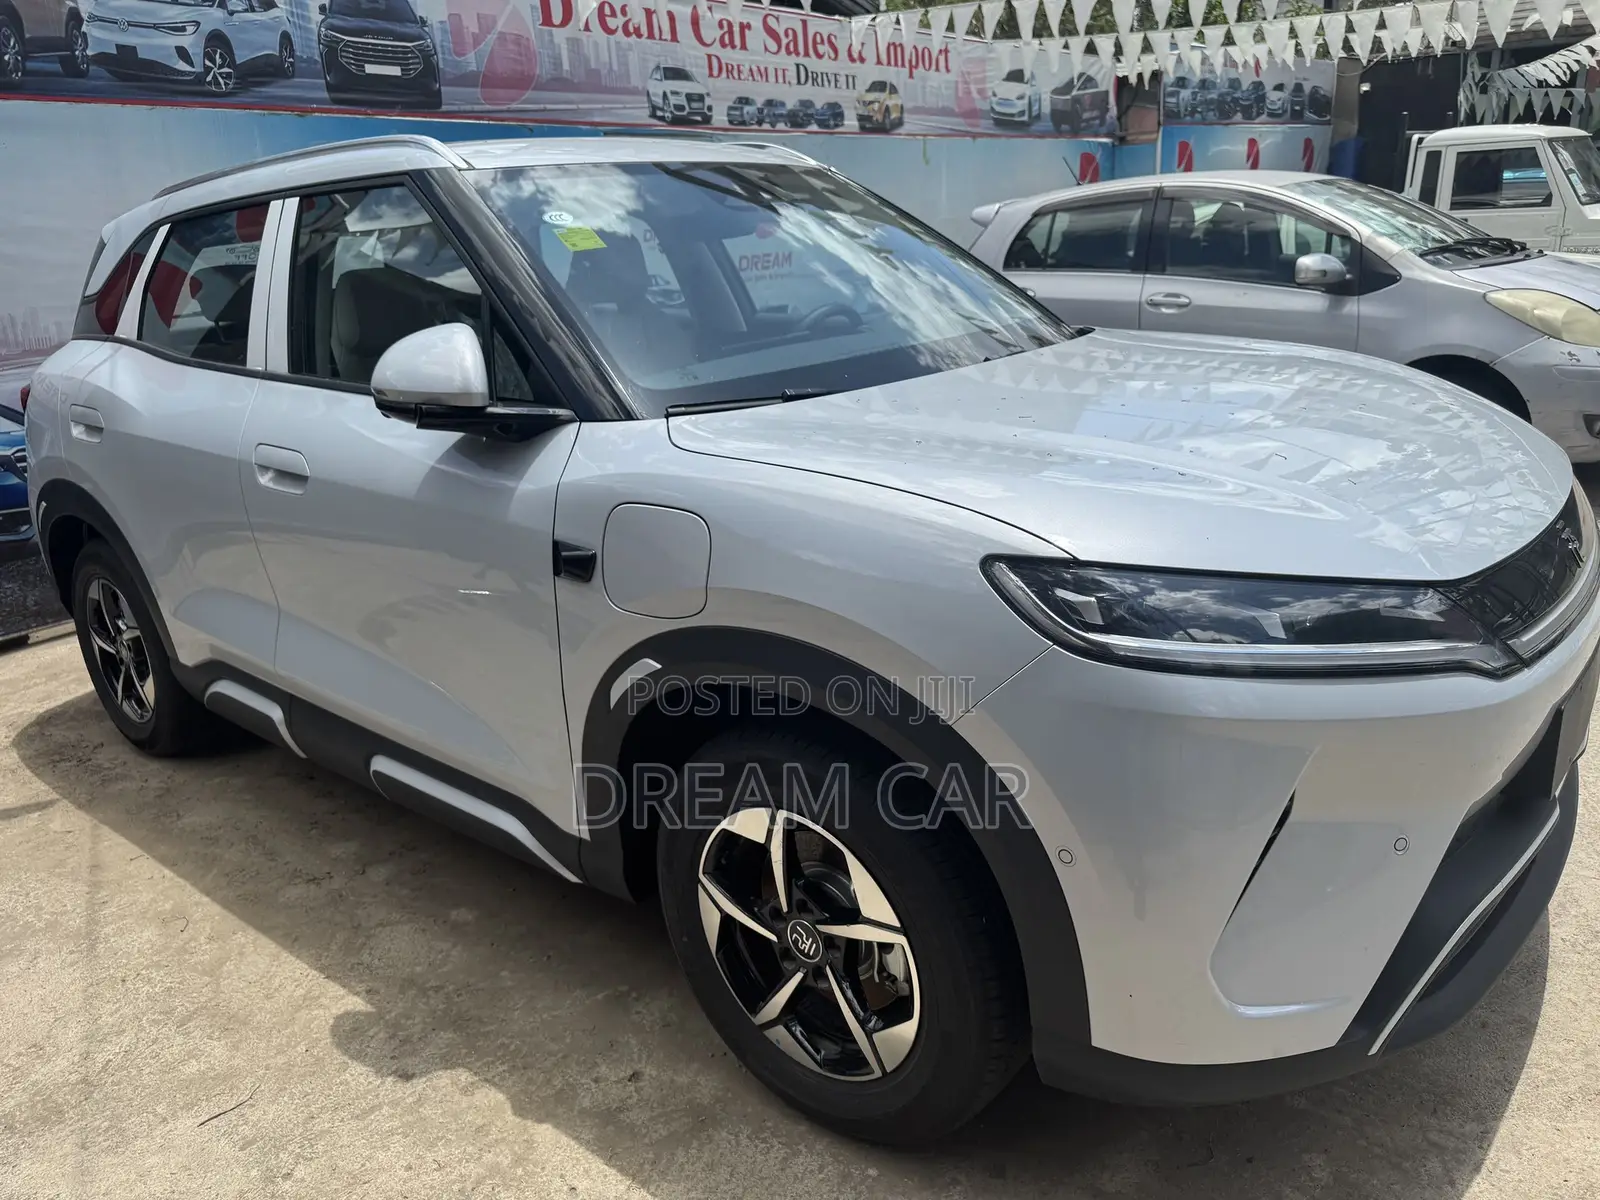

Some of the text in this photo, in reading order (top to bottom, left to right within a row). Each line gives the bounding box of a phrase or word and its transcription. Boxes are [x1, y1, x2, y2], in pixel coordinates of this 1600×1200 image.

[690, 4, 752, 50] Car
[763, 13, 839, 62] Sales
[705, 53, 769, 83] DREAM
[794, 63, 841, 89] DRIVE
[845, 74, 858, 90] IT
[739, 251, 792, 272] DREAM
